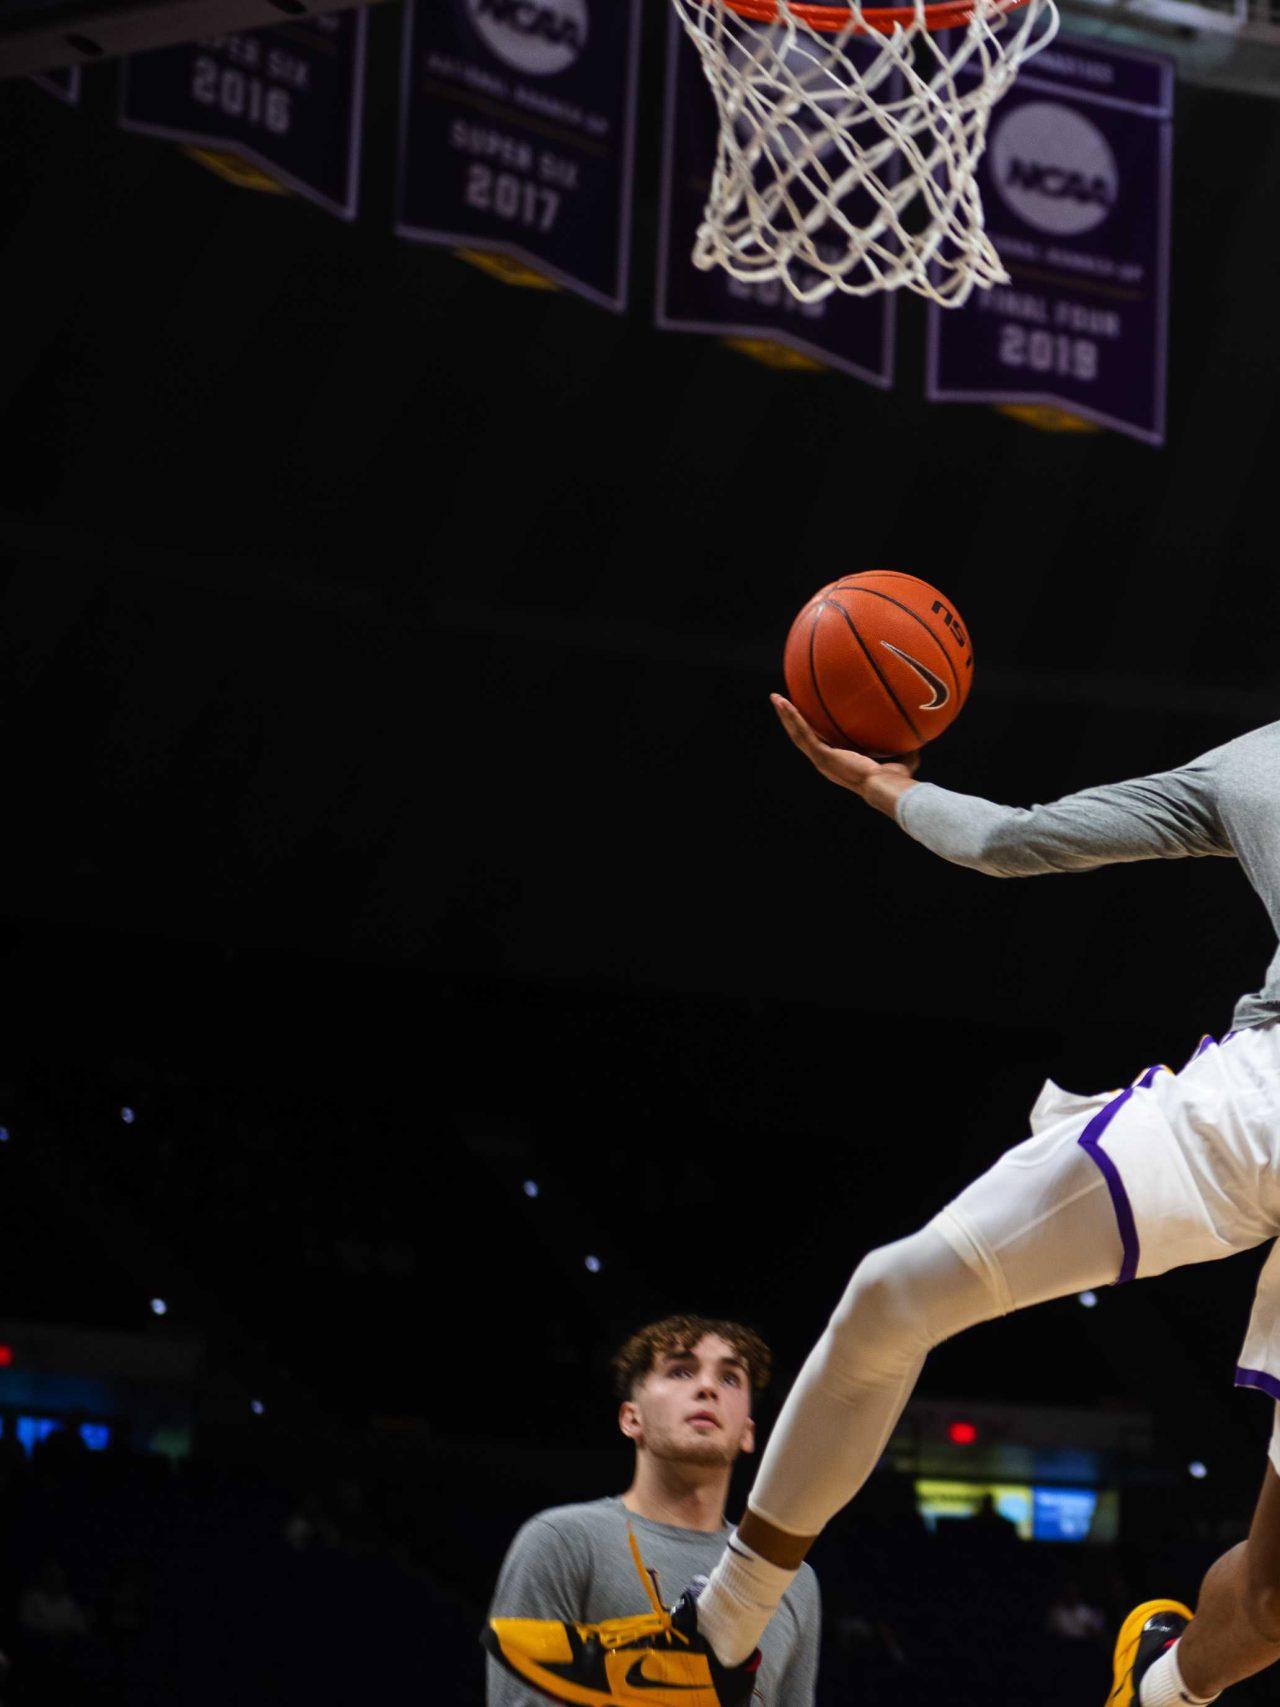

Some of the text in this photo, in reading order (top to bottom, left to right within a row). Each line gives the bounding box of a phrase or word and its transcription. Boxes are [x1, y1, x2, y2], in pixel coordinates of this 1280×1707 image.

[192, 56, 291, 135] 2016
[450, 119, 533, 171] SUPER
[466, 162, 561, 233] 2017
[1007, 156, 1112, 206] NCAA
[977, 287, 1121, 338] FINAL FOUR
[999, 322, 1098, 381] 2019
[931, 600, 973, 669] SU
